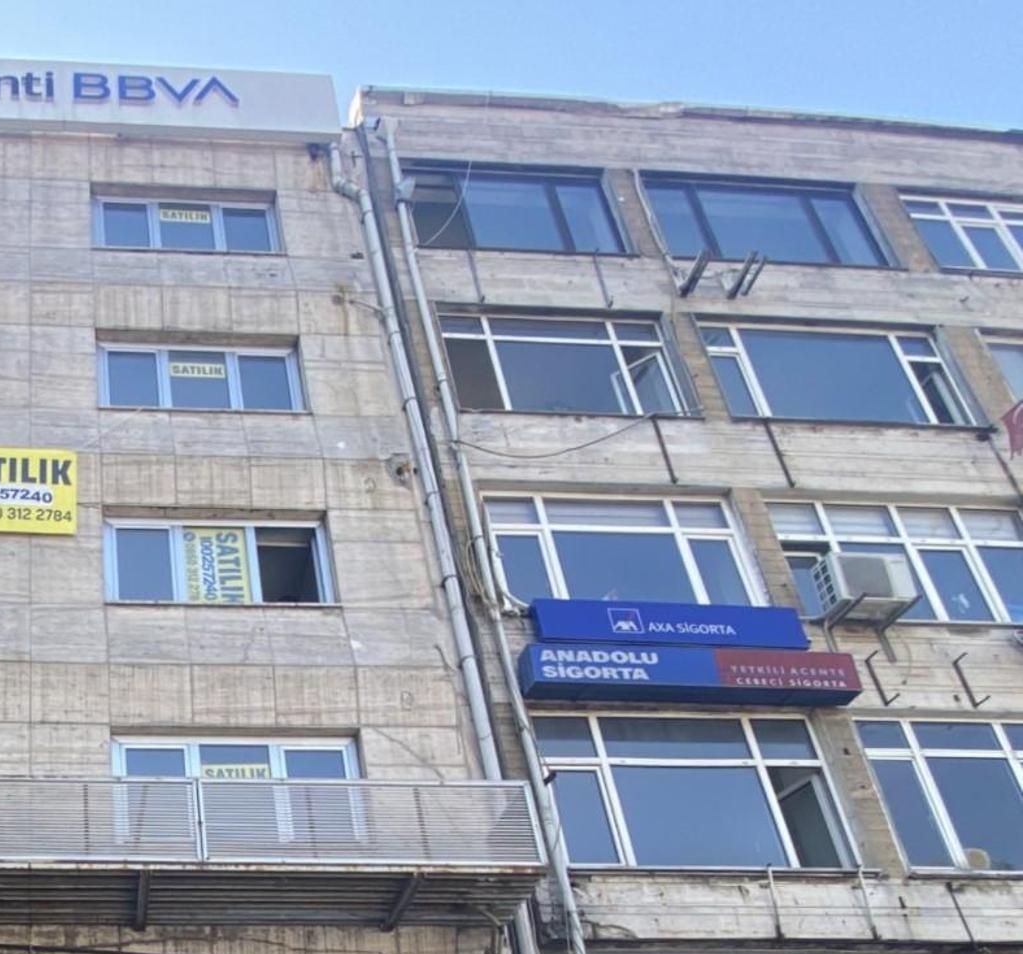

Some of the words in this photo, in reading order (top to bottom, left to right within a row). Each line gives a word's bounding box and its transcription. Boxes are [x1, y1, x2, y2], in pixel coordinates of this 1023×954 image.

[73, 71, 239, 104] BBVA
[161, 210, 209, 222] SATILIK
[171, 364, 225, 376] SATILIK
[7, 507, 31, 520] 312
[36, 508, 72, 522] 2784
[648, 622, 675, 634] AXA
[678, 621, 737, 636] SİGORTA
[540, 649, 659, 665] ANADOLU
[543, 662, 650, 681] SİGORTA
[205, 767, 267, 779] SATILIK
